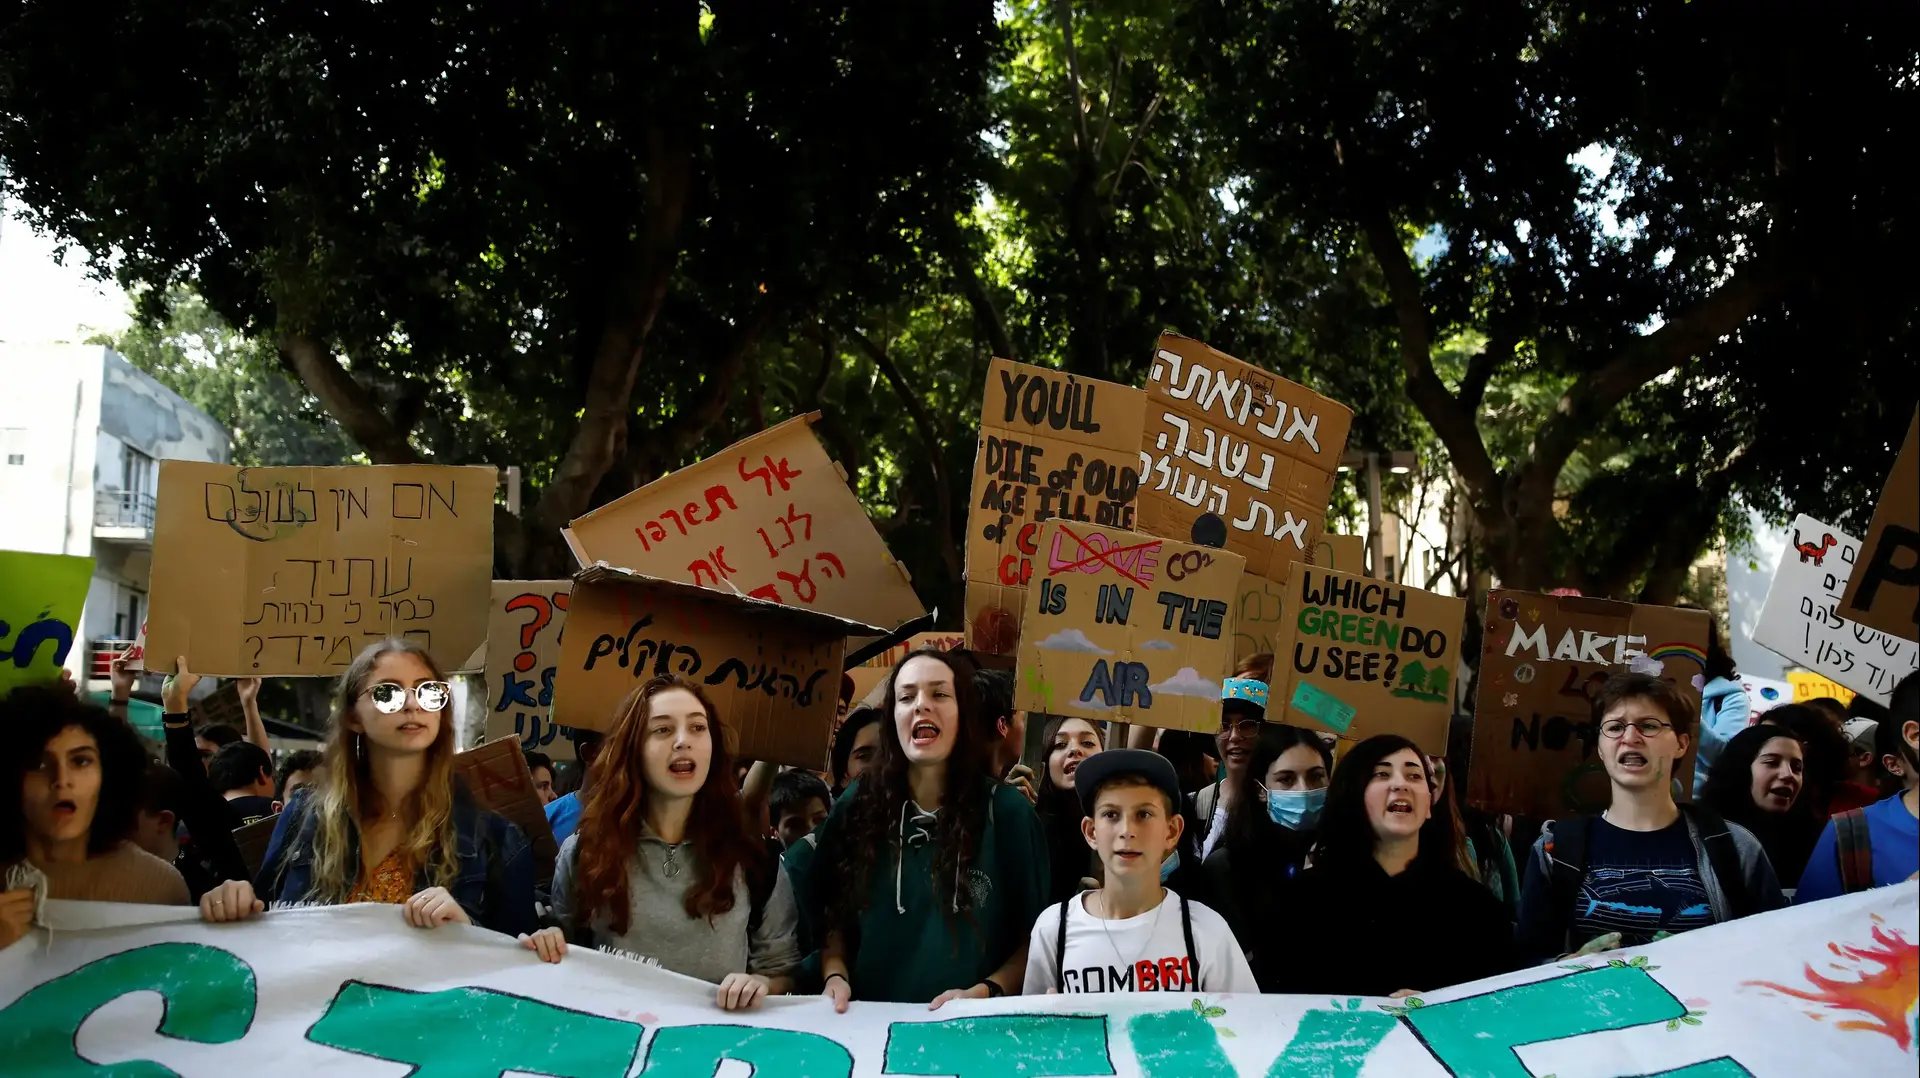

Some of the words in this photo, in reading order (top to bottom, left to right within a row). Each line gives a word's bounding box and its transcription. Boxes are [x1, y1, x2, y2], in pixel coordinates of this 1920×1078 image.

[1000, 369, 1101, 434] YOU'LL
[985, 435, 1044, 486] DIE
[1047, 452, 1083, 490] of
[1083, 459, 1139, 503] OLD
[1156, 411, 1275, 492] נשנה
[738, 455, 802, 496] אל
[205, 481, 317, 523] לעולם
[329, 486, 368, 532] אין
[392, 480, 459, 520] אם
[635, 485, 738, 552] תשרפו
[981, 480, 1027, 517] AGE
[1095, 500, 1135, 531] DIE
[756, 503, 812, 558] לנו
[983, 514, 1013, 544] of
[1232, 499, 1308, 550] את
[286, 557, 412, 598] עתיד
[1048, 530, 1163, 584] LOVE
[243, 600, 324, 625] להיות
[344, 600, 362, 624] לי
[379, 595, 435, 621] למה
[1039, 578, 1067, 615] IS
[1095, 583, 1134, 626] IN
[1157, 591, 1228, 640] THE
[1303, 571, 1406, 618] WHICH
[1297, 606, 1399, 650] GREEN
[1400, 626, 1447, 659] DO
[1504, 621, 1647, 667] MAKE
[1079, 658, 1152, 709] AIR
[1294, 642, 1319, 674] U
[1323, 647, 1399, 687] SEE?
